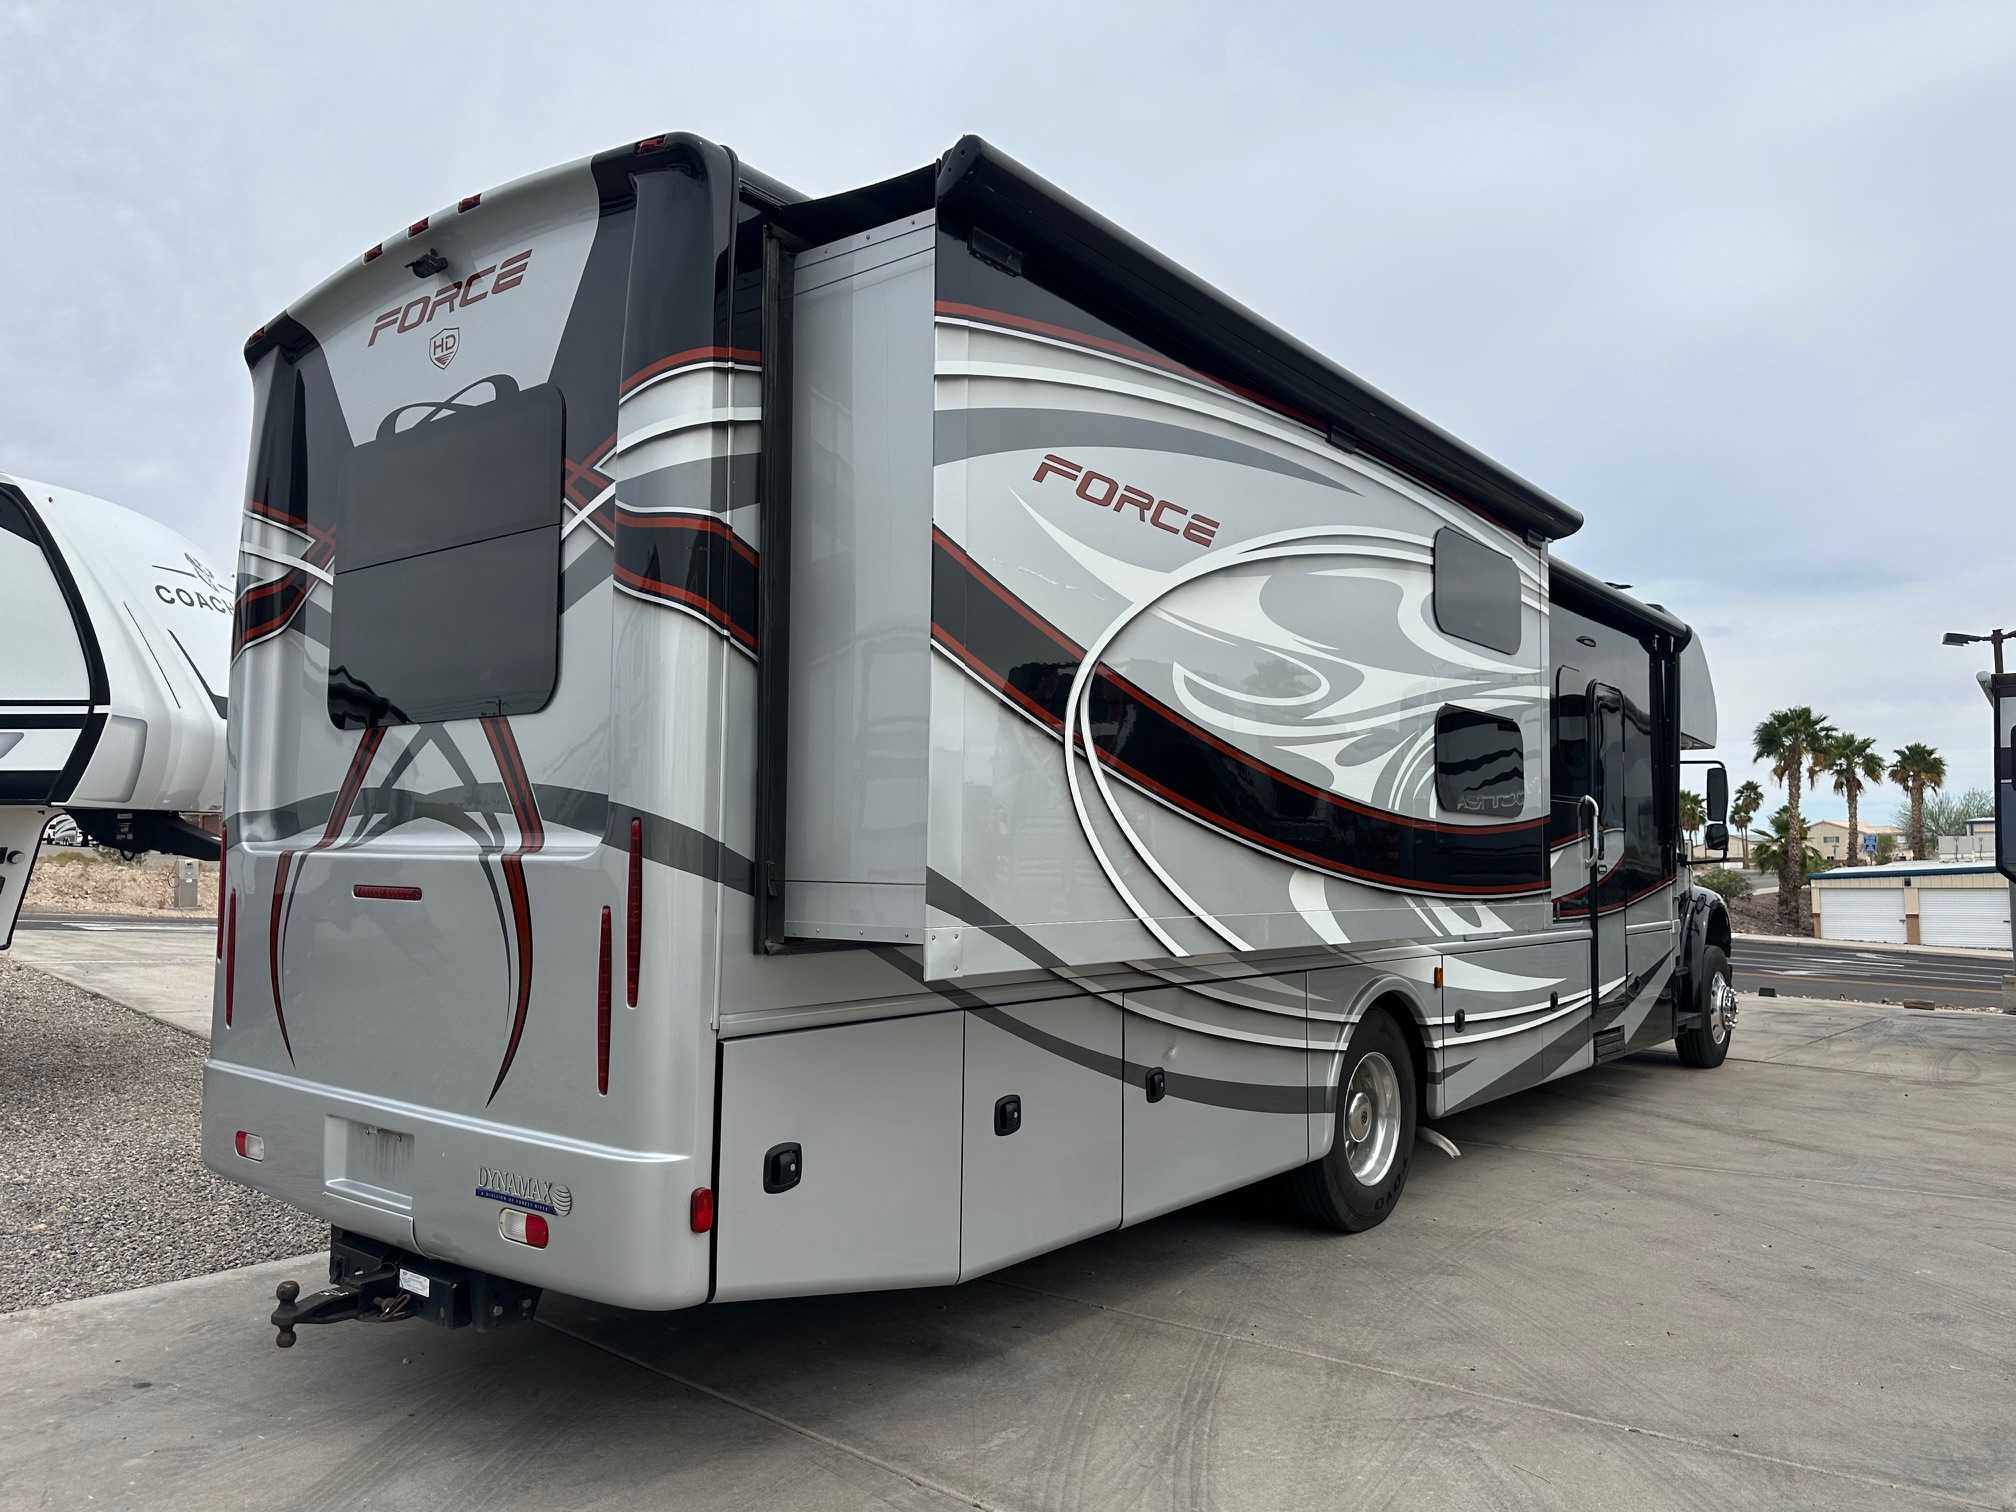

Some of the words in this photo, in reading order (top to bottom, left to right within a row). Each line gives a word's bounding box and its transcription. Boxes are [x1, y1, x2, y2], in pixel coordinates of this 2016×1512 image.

[367, 249, 533, 348] FORCE
[433, 333, 457, 356] HD
[1032, 453, 1221, 548] FORCE
[478, 1165, 554, 1205] DYNAMAX
[515, 1198, 533, 1208] FOREST
[534, 1202, 548, 1212] RIVER
